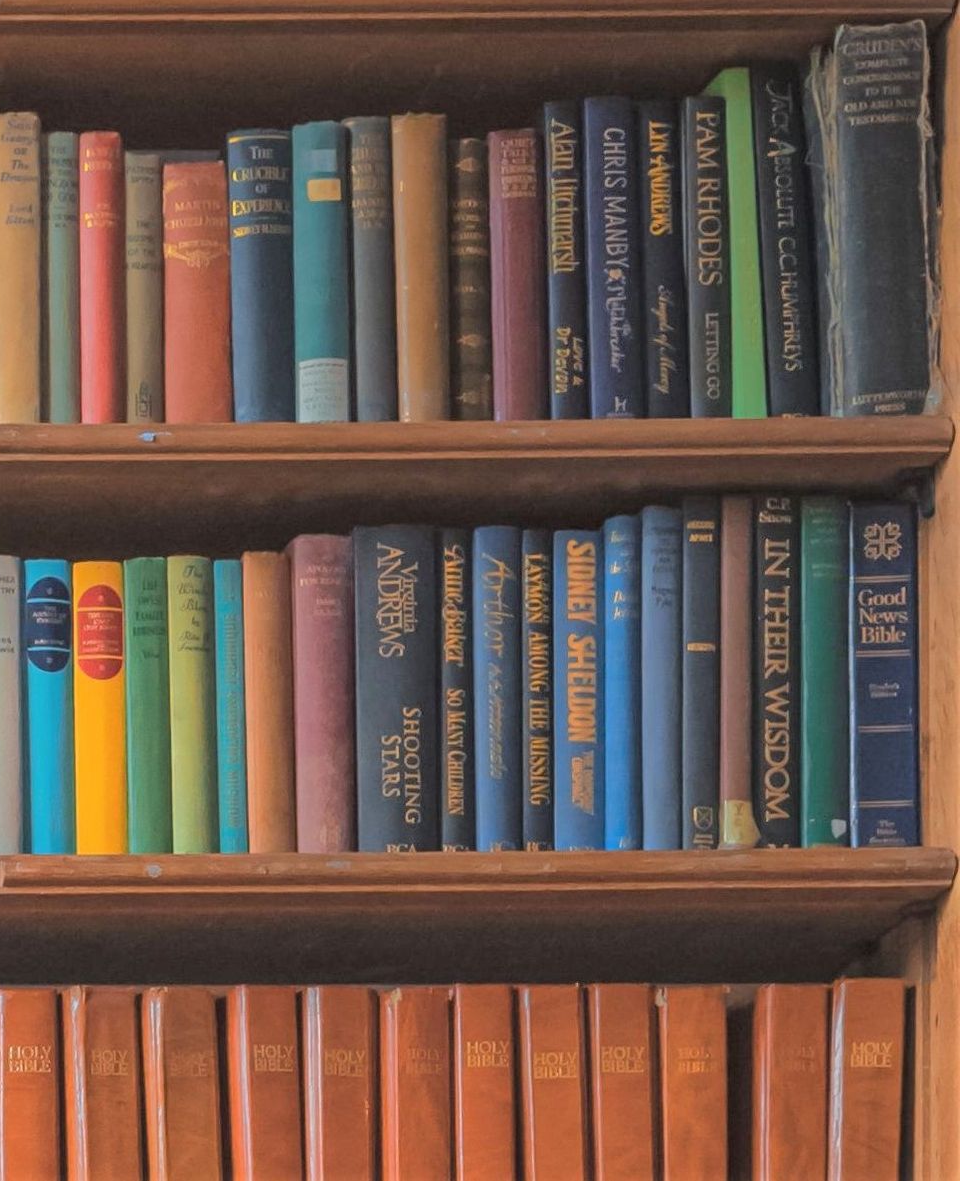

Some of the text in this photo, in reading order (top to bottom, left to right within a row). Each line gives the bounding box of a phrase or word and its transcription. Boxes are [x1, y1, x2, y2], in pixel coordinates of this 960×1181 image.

[842, 39, 922, 56] CRUDEN'S
[550, 118, 578, 170] Alan
[648, 120, 674, 237] LYN ANDREWS
[602, 127, 629, 269] CHRIS MANBY
[695, 111, 723, 287] PAM RHODES
[704, 311, 720, 401] LETTING GO
[402, 561, 419, 633] Virginia
[525, 553, 544, 624] LAYMON
[857, 587, 907, 606] Good
[376, 542, 404, 659] ANDREWS
[443, 544, 466, 667] Anne Baker
[858, 606, 909, 625] News
[566, 539, 597, 744] SIDNEY SHELDON
[860, 625, 907, 644] Bible
[764, 537, 791, 823] IN THEIR WISDOM
[528, 631, 551, 806] AMONG THE MISSING
[446, 687, 467, 816] SO MANY CHILDREN
[381, 734, 401, 798] STARS
[402, 706, 422, 825] SHOOTING
[8, 1044, 52, 1059] HOLY
[253, 1044, 295, 1058] HOLY
[324, 1050, 366, 1063] HOLY
[465, 1041, 510, 1054] HOLY
[600, 1046, 646, 1059] HOLY
[851, 1041, 894, 1054] HOLY
[8, 1059, 52, 1073] BIBLE
[254, 1058, 295, 1072] BIBLE
[466, 1054, 510, 1068] BIBLE
[533, 1052, 578, 1065] HOLY
[601, 1059, 645, 1073] BIBLE
[850, 1054, 893, 1068] BIBLE
[324, 1064, 366, 1077] BIBLE
[533, 1065, 578, 1079] BIBLE
